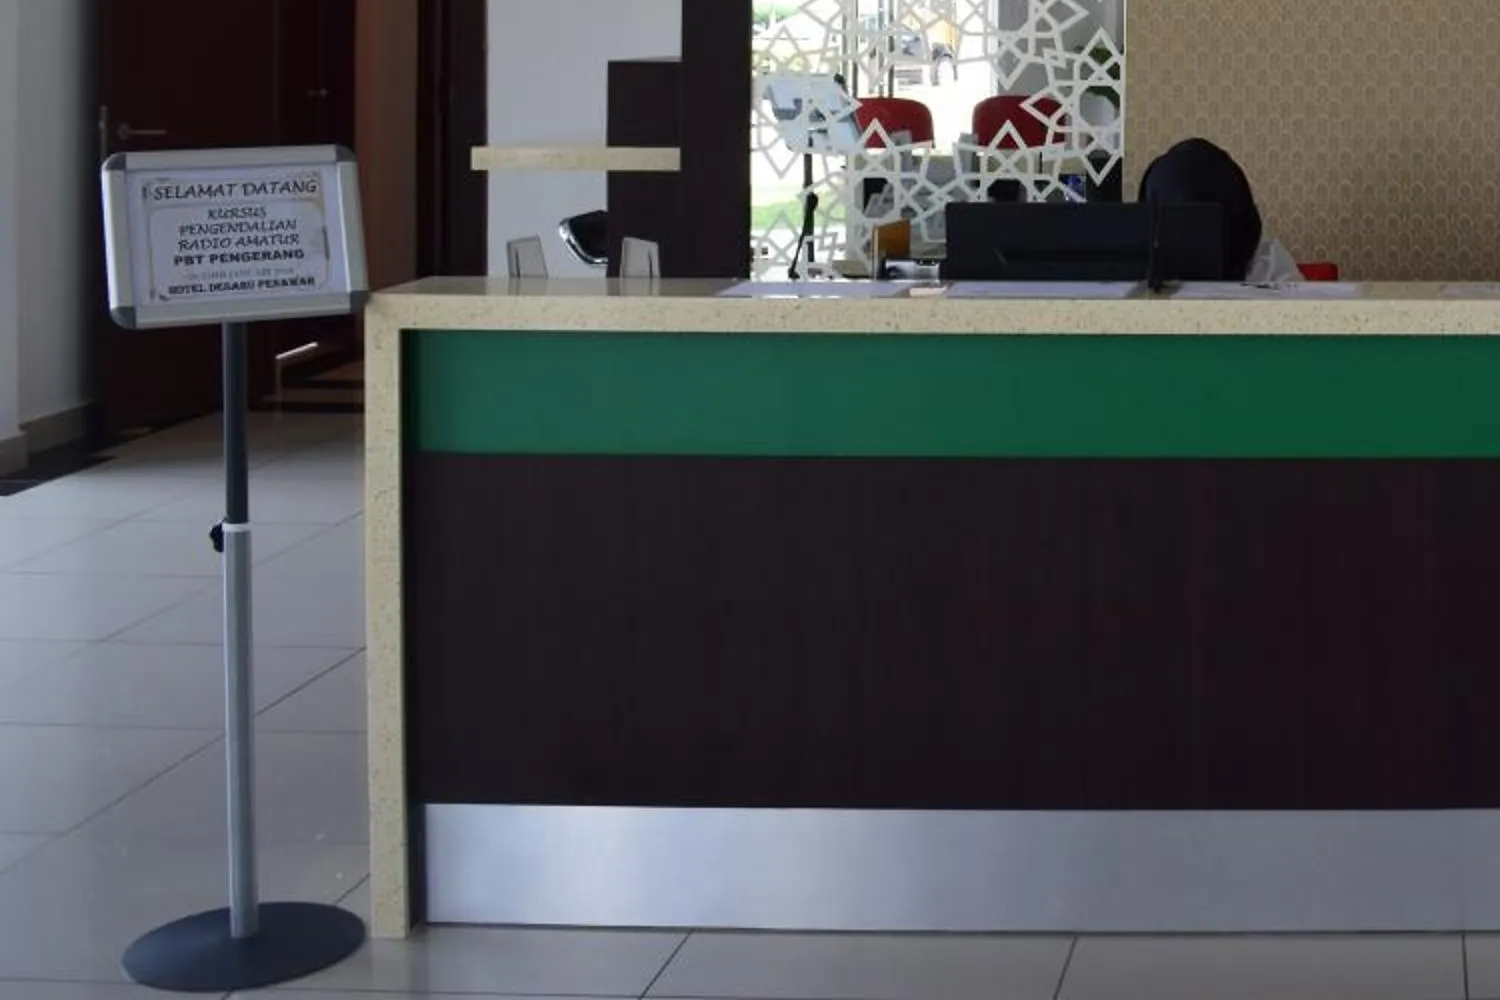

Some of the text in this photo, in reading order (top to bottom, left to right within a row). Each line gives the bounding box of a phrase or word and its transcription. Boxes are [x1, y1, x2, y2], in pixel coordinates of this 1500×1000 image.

[153, 179, 317, 201] SELAMAT DATANG
[207, 206, 267, 219] KURSUS
[178, 219, 297, 236] PENGENDALIAN
[178, 233, 300, 252] RADIO AMATUR
[173, 249, 305, 266] PBT PENGERANG
[168, 282, 207, 295] HOTEL
